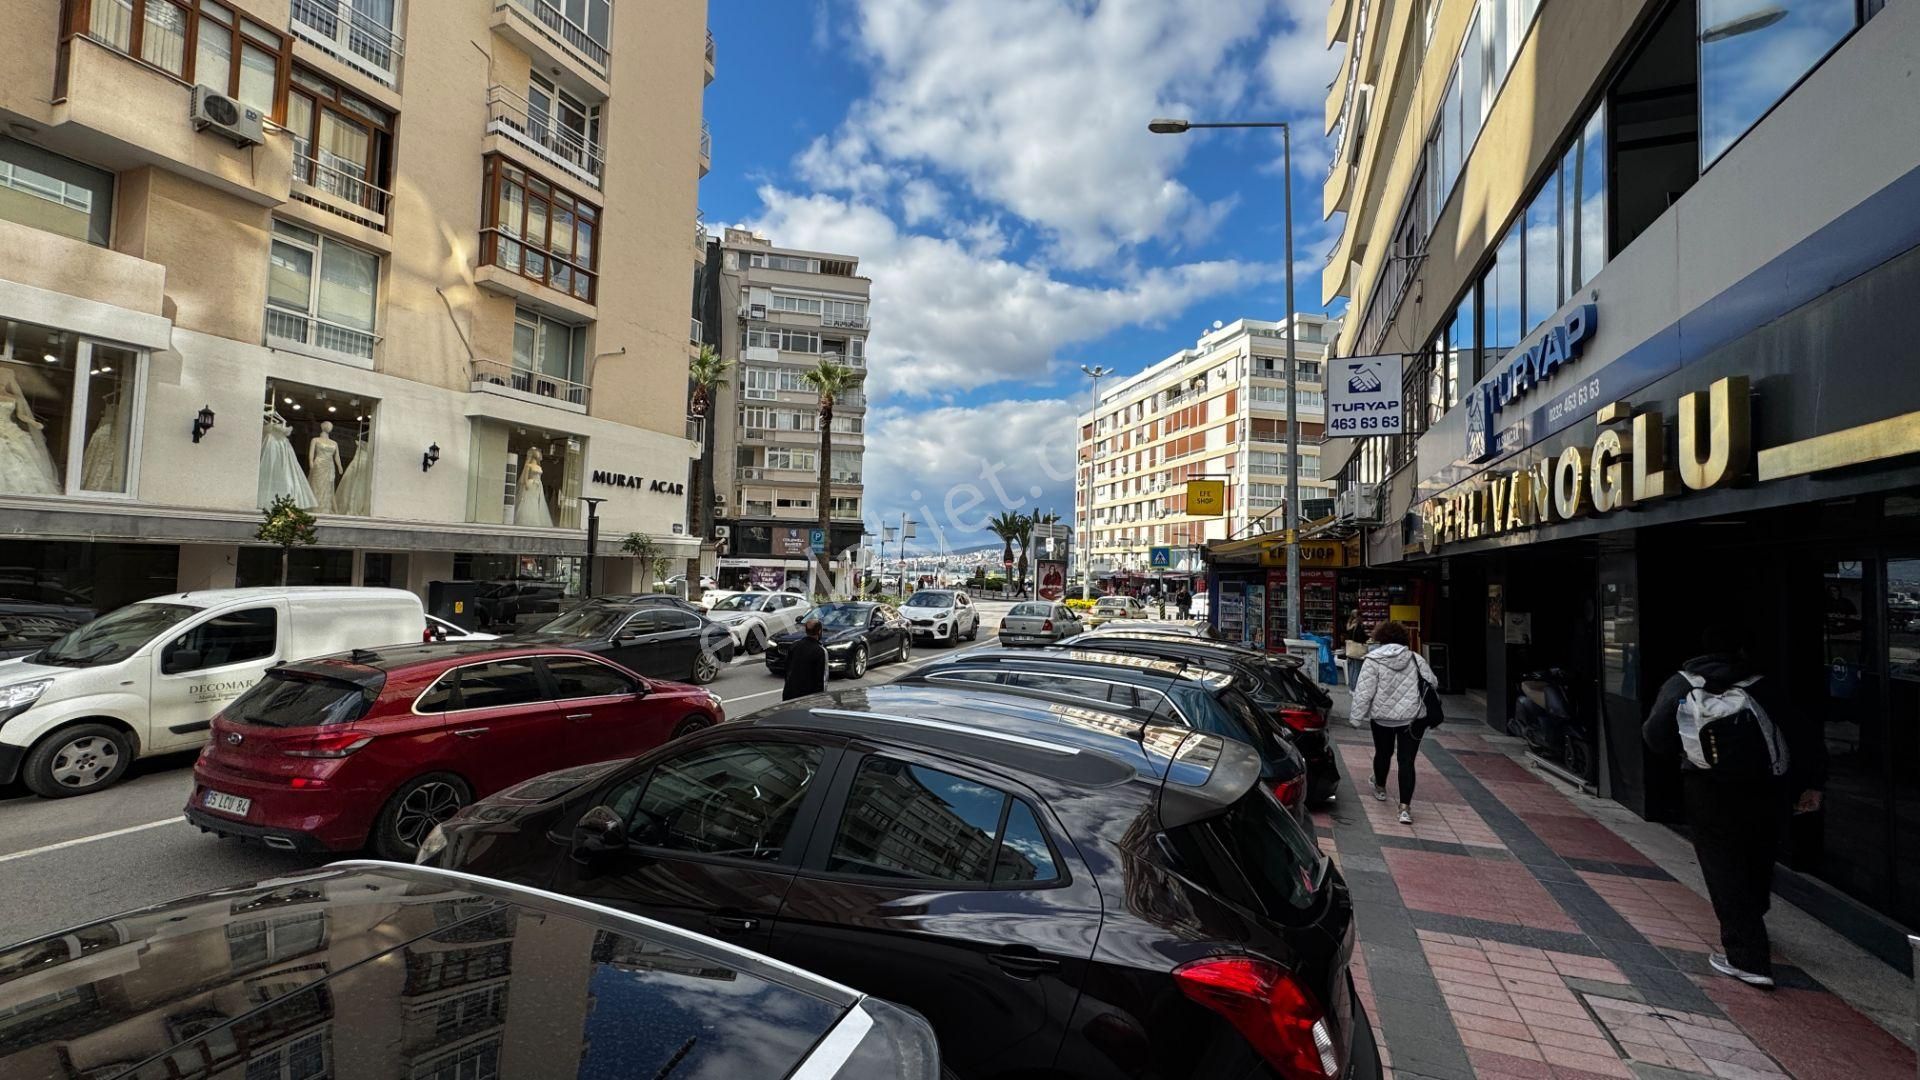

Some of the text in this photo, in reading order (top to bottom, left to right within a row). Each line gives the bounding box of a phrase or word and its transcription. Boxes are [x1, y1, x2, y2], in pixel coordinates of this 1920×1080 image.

[1484, 304, 1597, 413] TURYAP
[1331, 401, 1399, 412] TURYAP
[1549, 378, 1600, 423] 0232 463 63 63
[1331, 416, 1399, 430] 463 63 63
[592, 470, 684, 495] MURAT ACAR
[1196, 497, 1214, 505] SHOP
[189, 679, 254, 694] DECOMAR
[236, 800, 247, 812] 84
